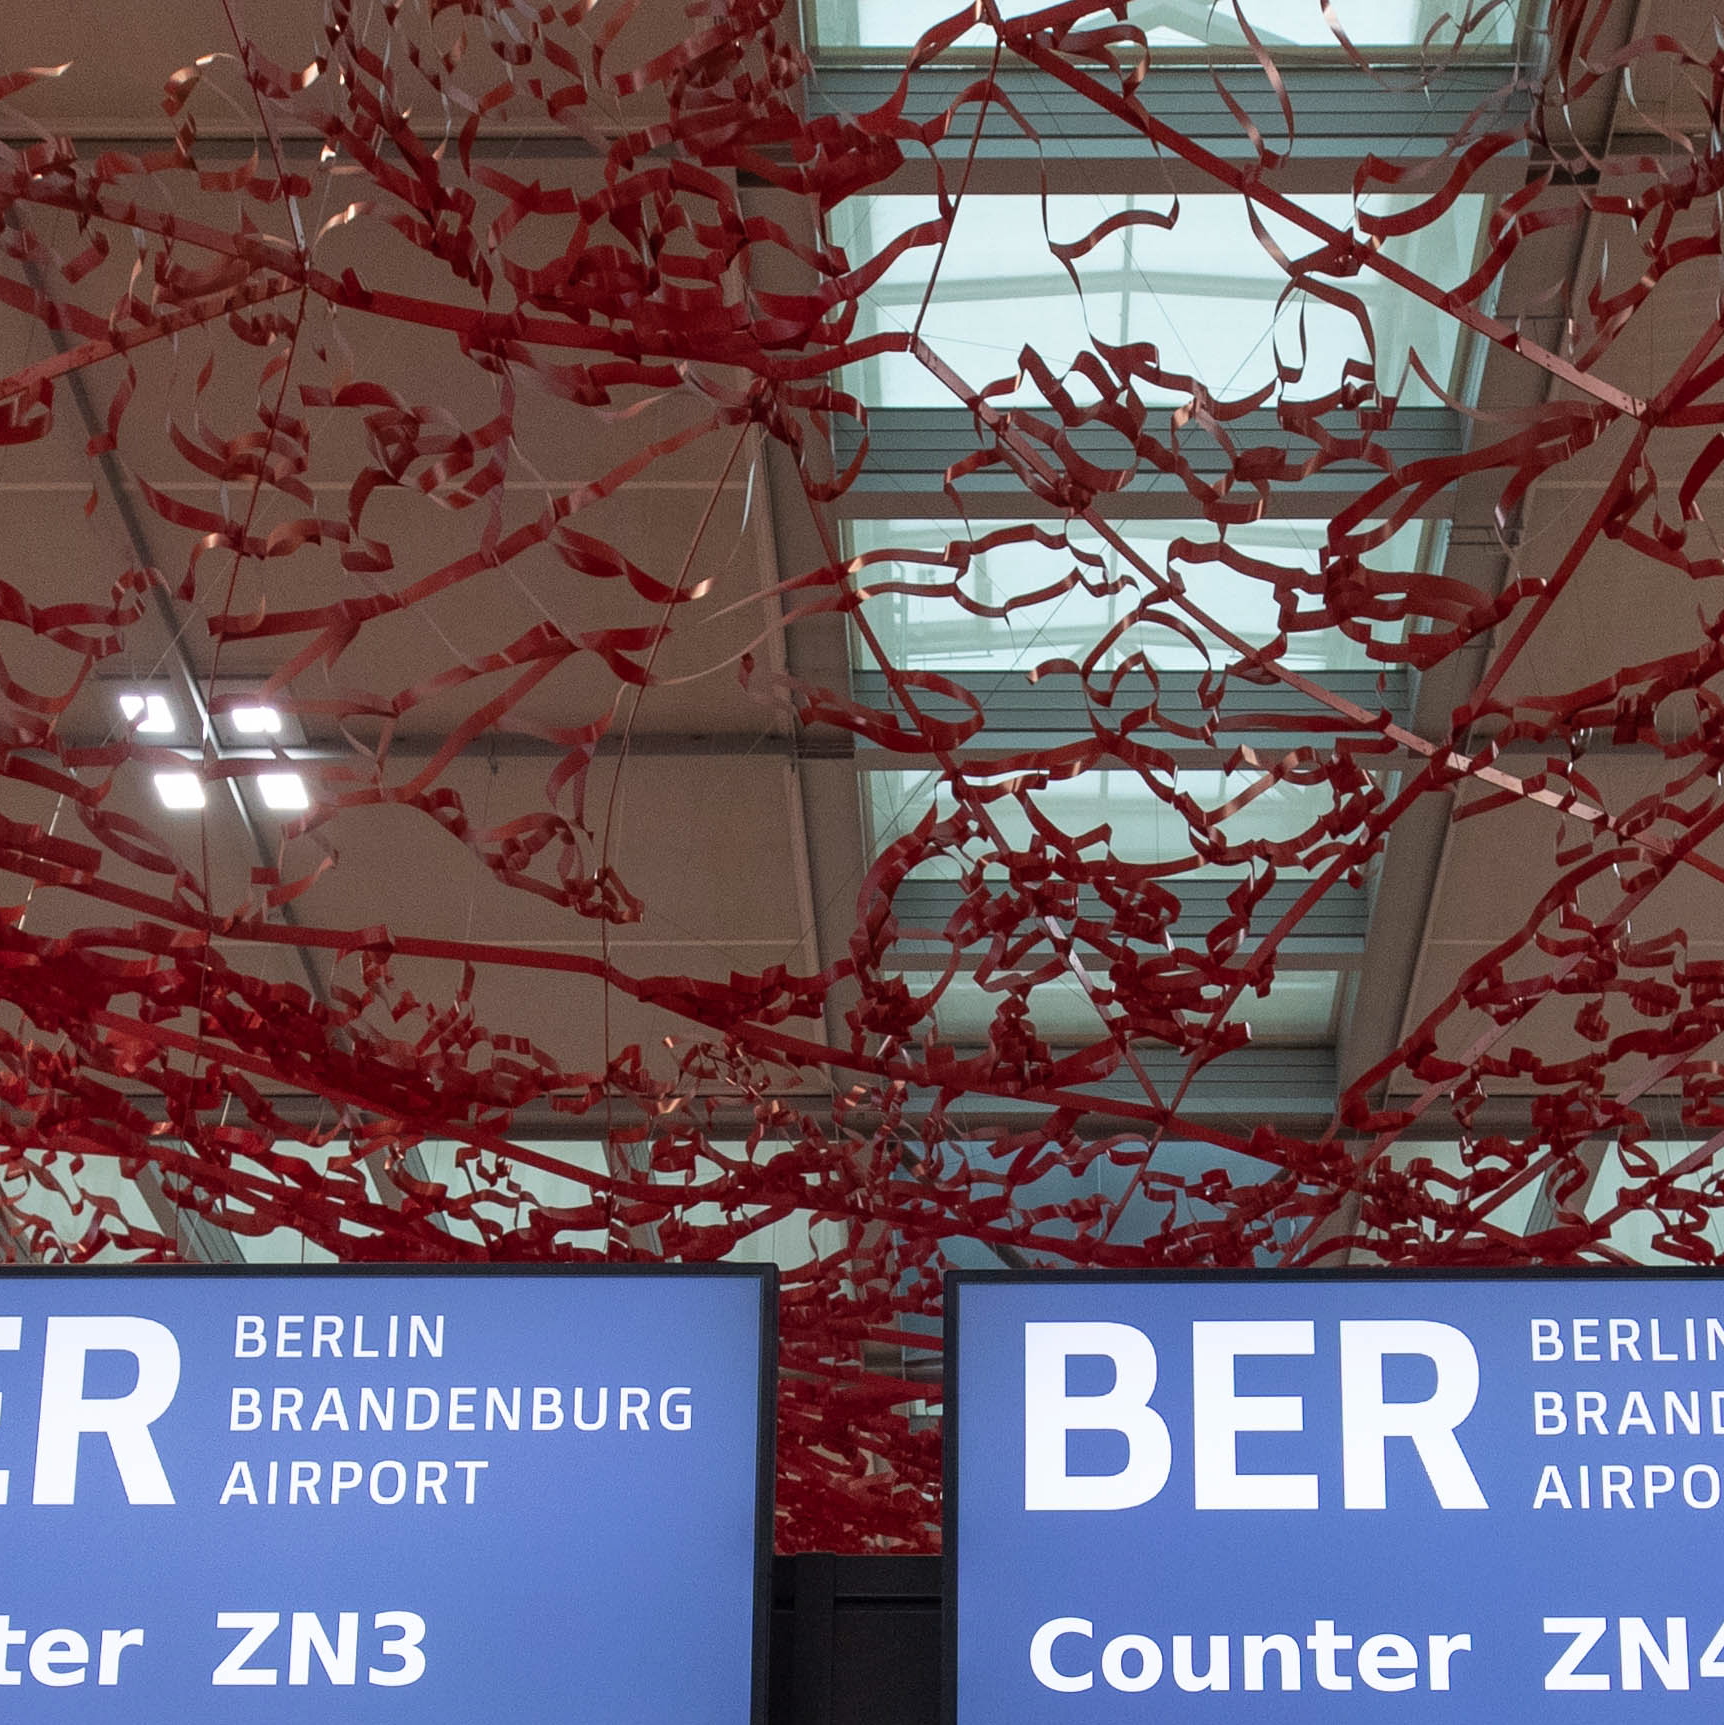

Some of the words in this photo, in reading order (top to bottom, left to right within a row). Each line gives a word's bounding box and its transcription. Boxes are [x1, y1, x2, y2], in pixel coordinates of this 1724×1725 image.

[234, 1315, 444, 1358] BERLIN
[229, 1386, 692, 1432] BRANDENBURG
[1024, 1319, 1489, 1511] BER
[219, 1460, 489, 1505] AIRPORT
[211, 1610, 426, 1687] ZN3
[1029, 1617, 1472, 1693] Counter
